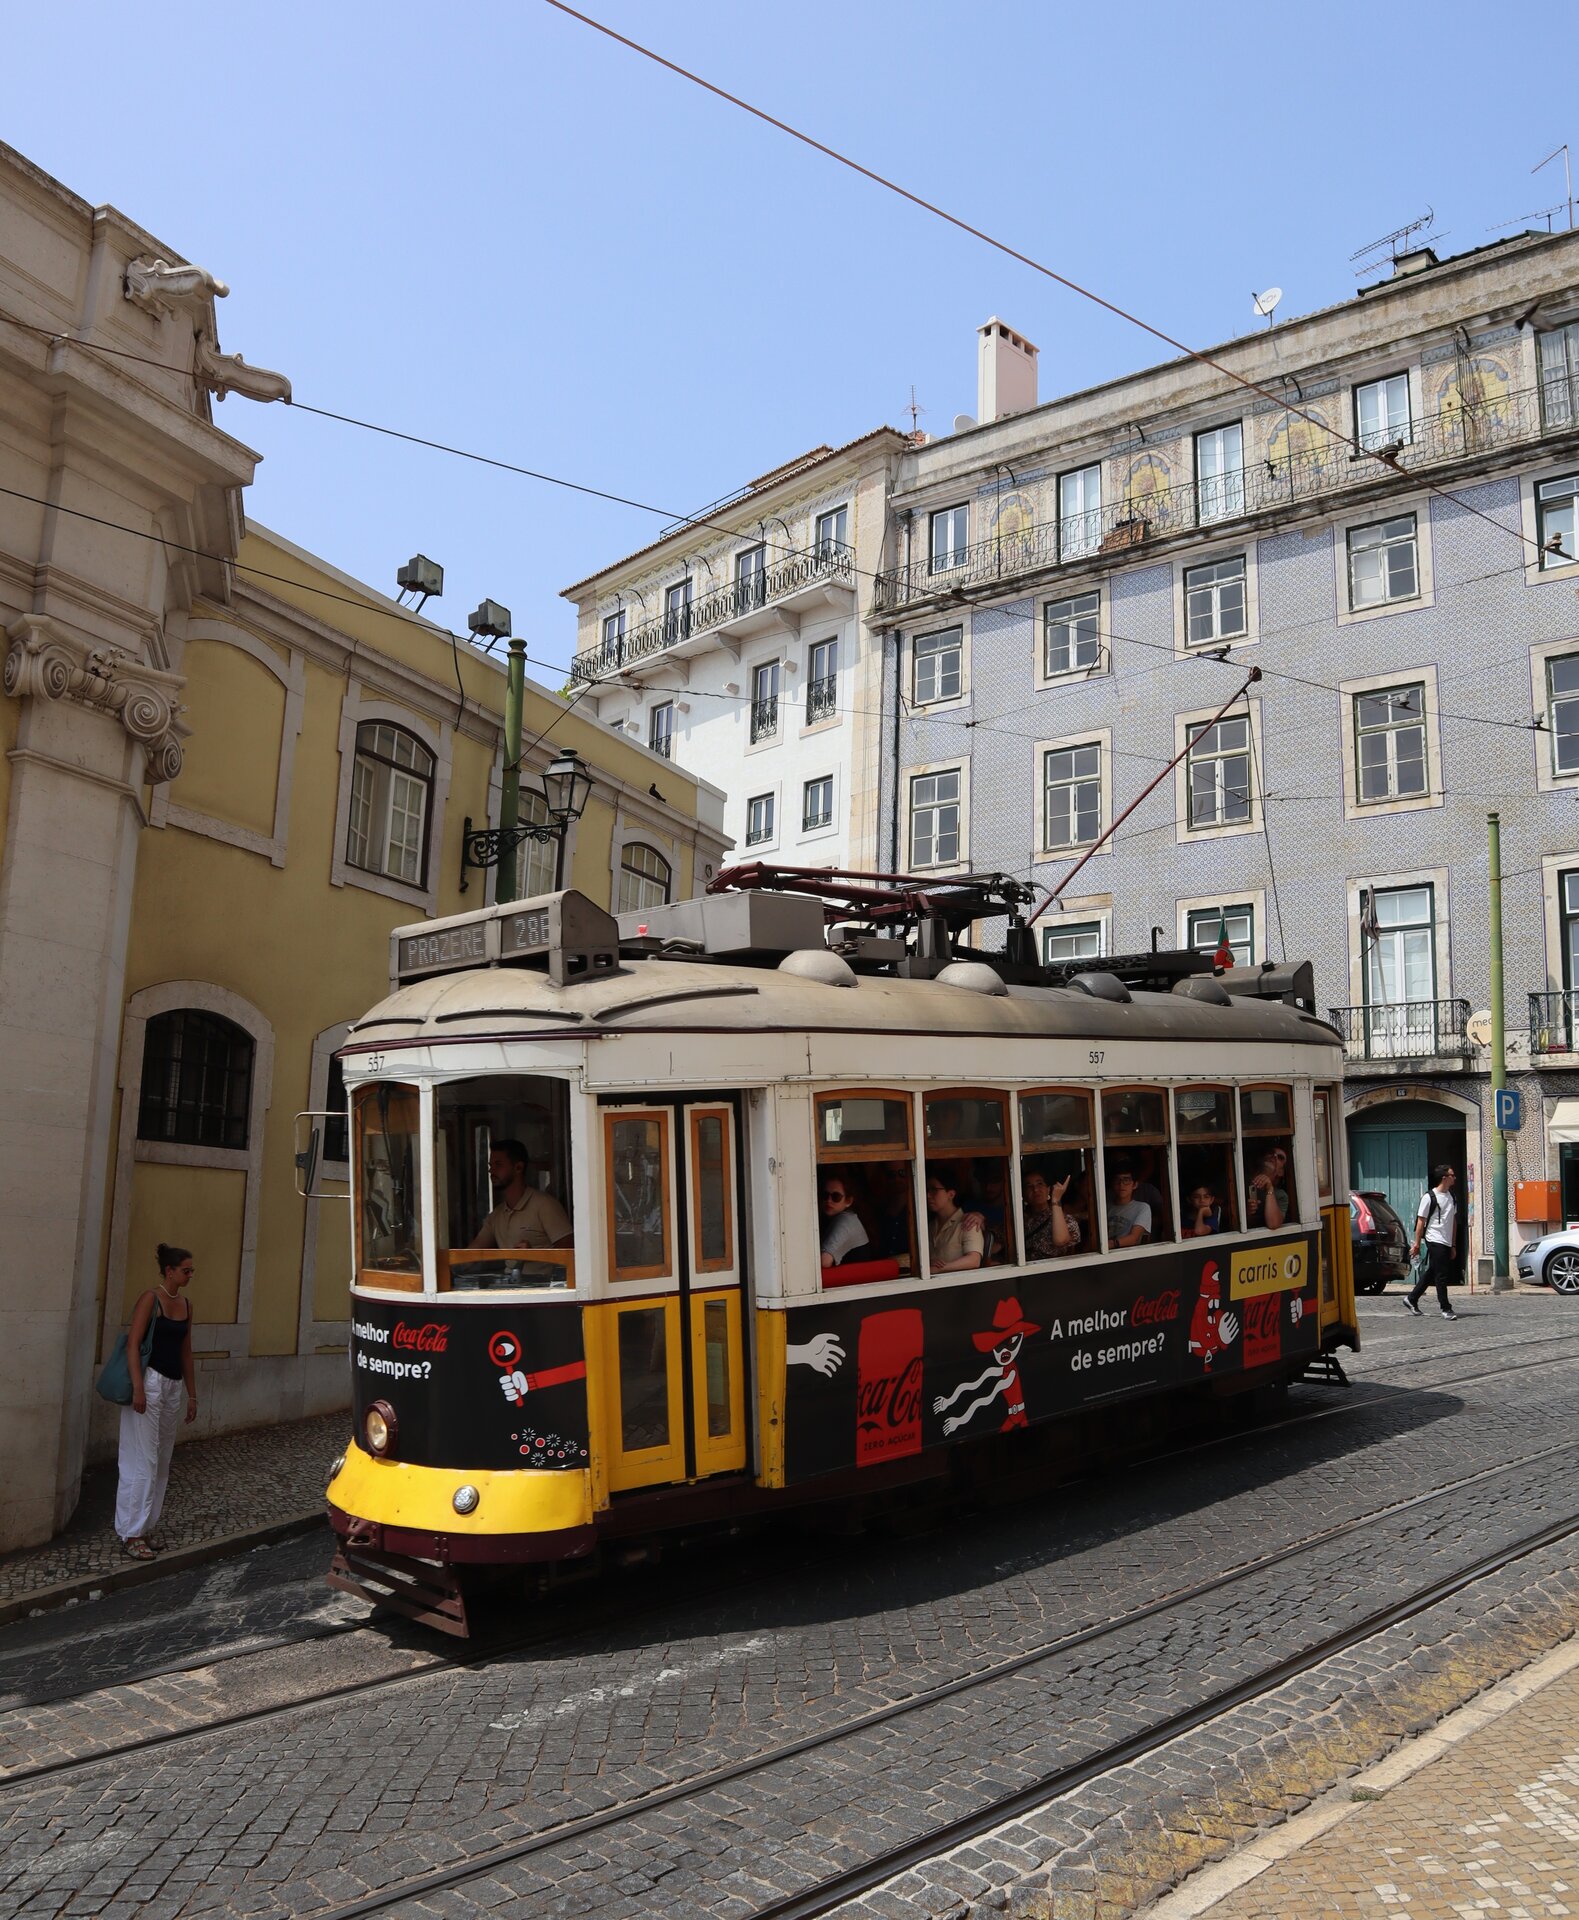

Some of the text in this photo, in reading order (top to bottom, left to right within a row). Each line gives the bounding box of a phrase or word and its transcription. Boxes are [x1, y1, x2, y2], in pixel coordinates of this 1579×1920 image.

[407, 925, 487, 967] PRAZERE
[368, 1055, 385, 1072] 557
[1089, 1051, 1105, 1064] 557
[1501, 1095, 1515, 1125] P
[1238, 1257, 1278, 1285] carris
[1050, 1289, 1181, 1341] A melhor Coca-Cola
[355, 1321, 389, 1344] melhor
[392, 1320, 453, 1352] Coca-Cola
[357, 1349, 432, 1380] de sempre?
[1071, 1332, 1165, 1372] de sempre?
